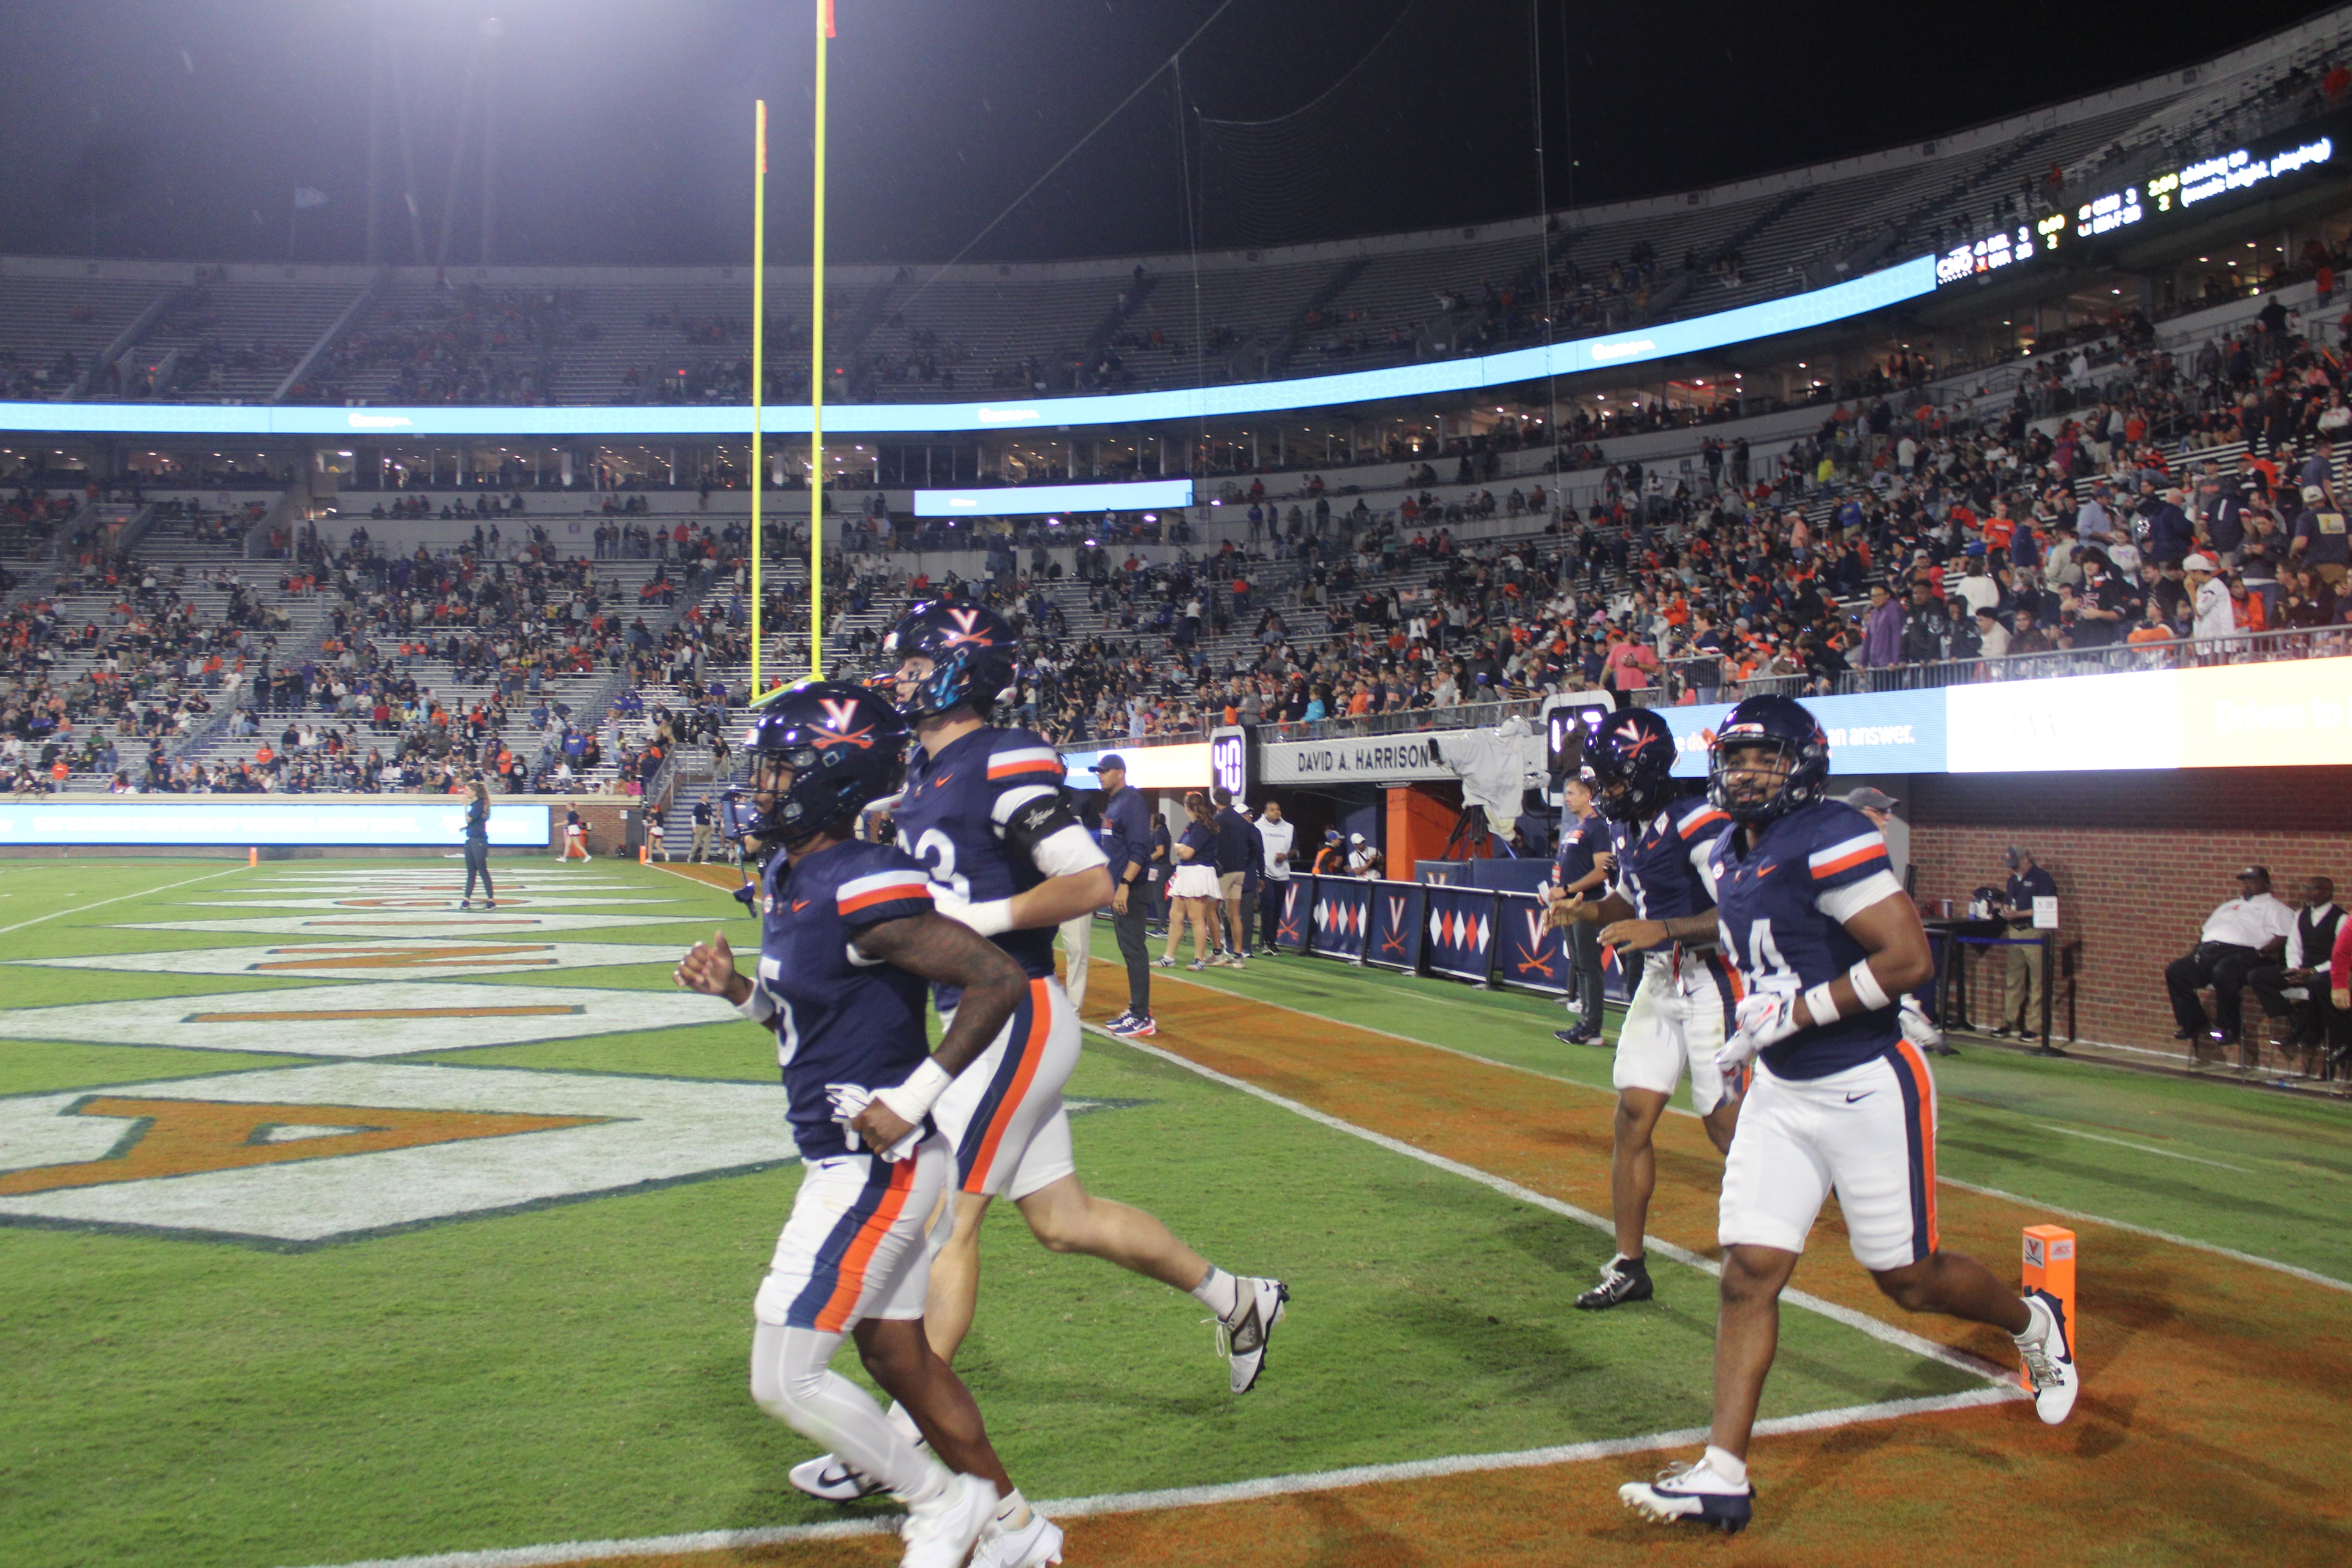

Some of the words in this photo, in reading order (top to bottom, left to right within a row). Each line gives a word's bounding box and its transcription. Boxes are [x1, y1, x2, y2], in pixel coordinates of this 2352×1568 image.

[1850, 723, 1915, 745] answer.
[1215, 740, 1240, 791] 40
[1298, 751, 1333, 772] DAVID
[1339, 751, 1350, 771] A.
[1356, 745, 1429, 769] HARRISON
